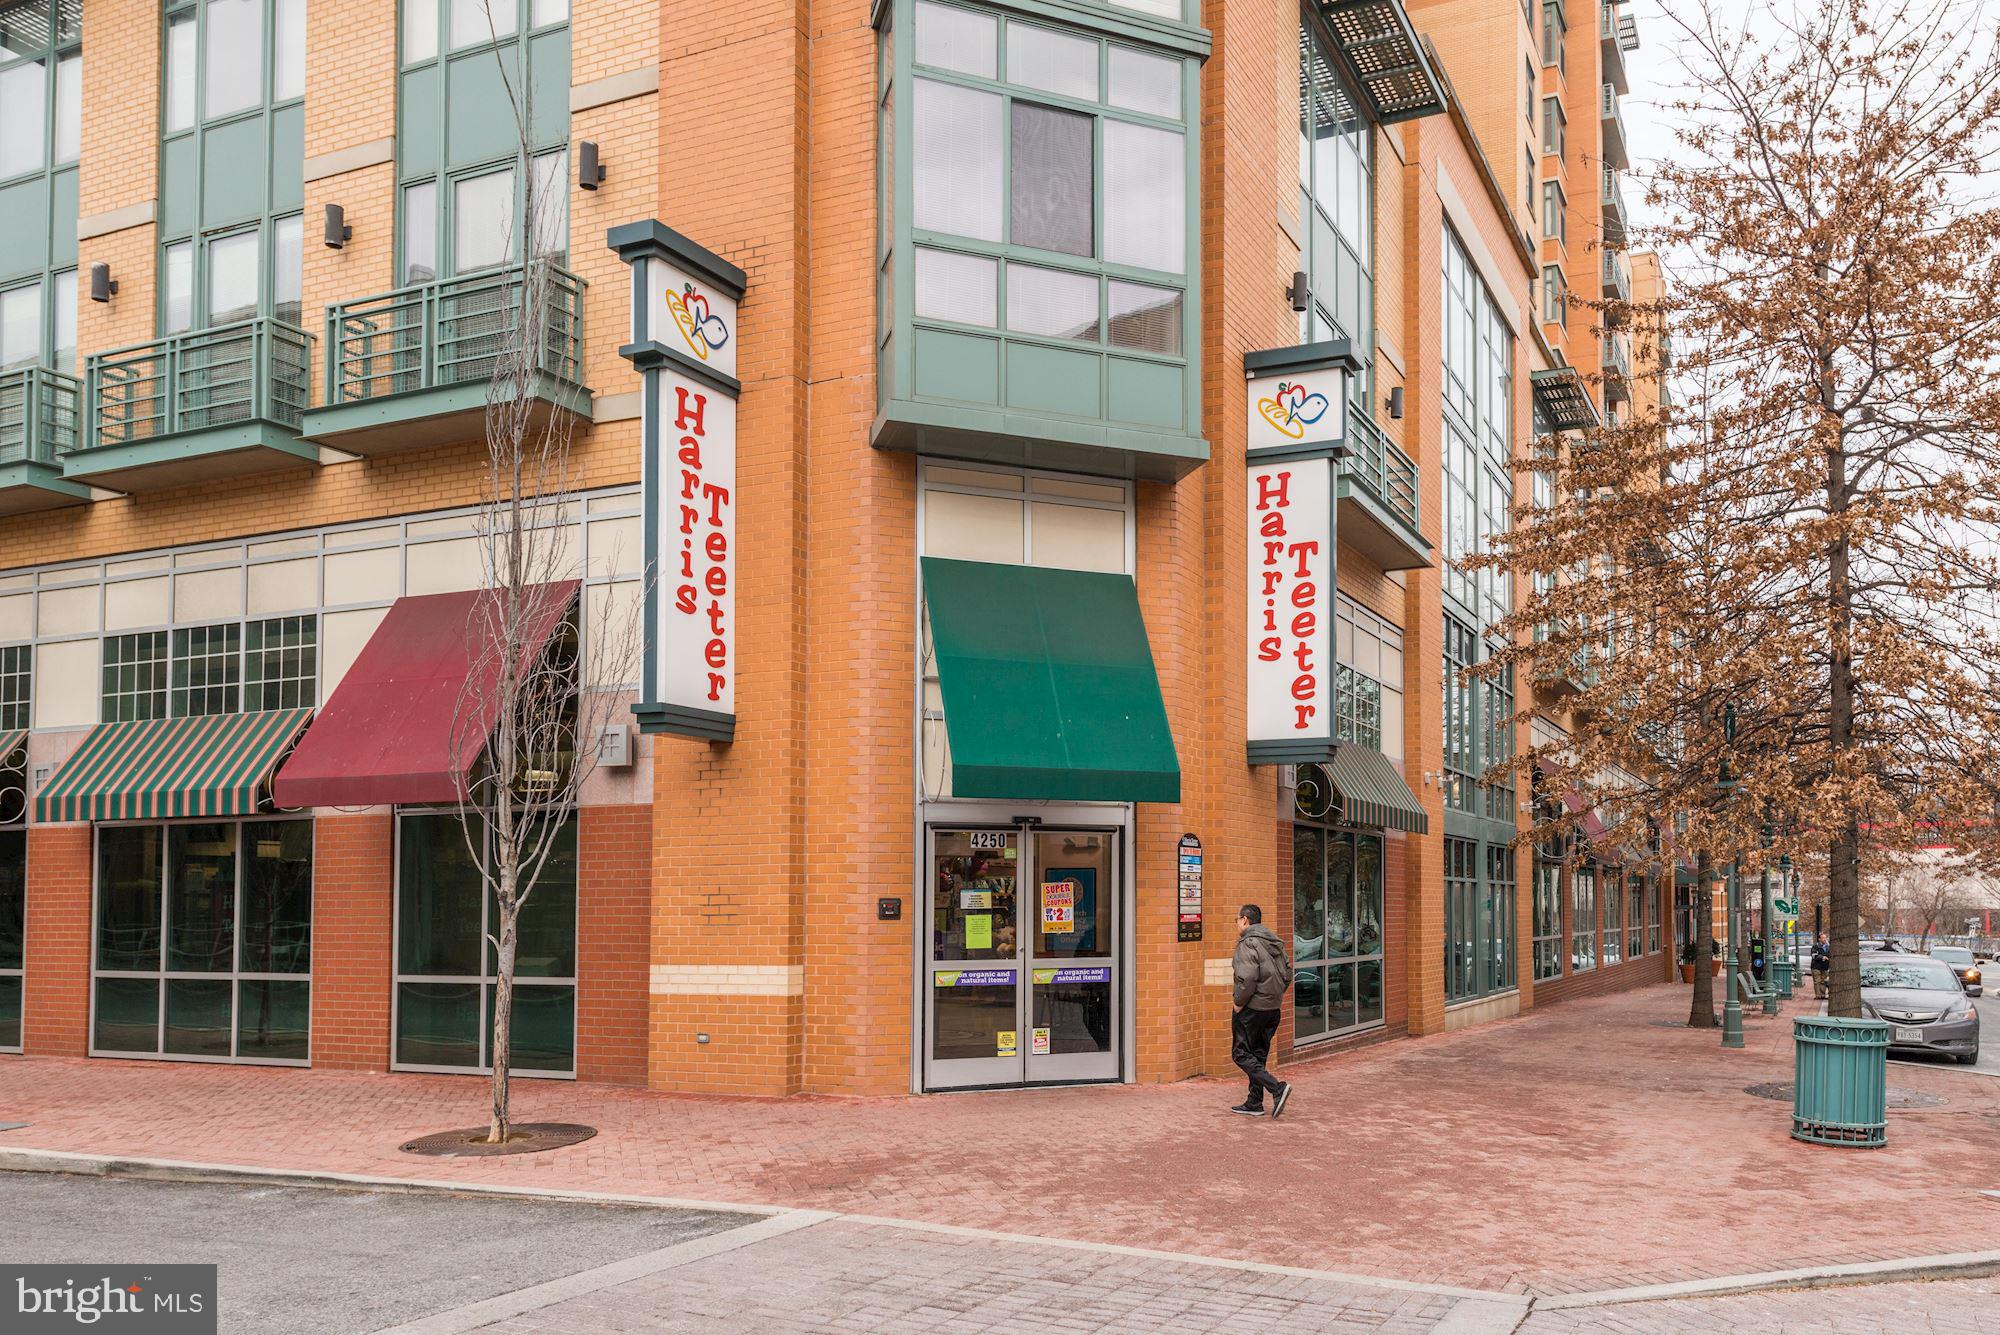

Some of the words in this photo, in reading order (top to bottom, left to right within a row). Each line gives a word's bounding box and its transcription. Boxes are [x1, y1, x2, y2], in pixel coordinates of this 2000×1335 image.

[675, 386, 707, 615] Harris
[703, 482, 729, 701] Teeter
[1256, 471, 1291, 662] Harris
[1288, 541, 1319, 729] Teeter
[971, 833, 1006, 848] 4250
[1045, 884, 1071, 894] SUPER
[1046, 898, 1072, 906] COUPONS
[968, 971, 996, 979] organic
[1064, 969, 1090, 977] organic
